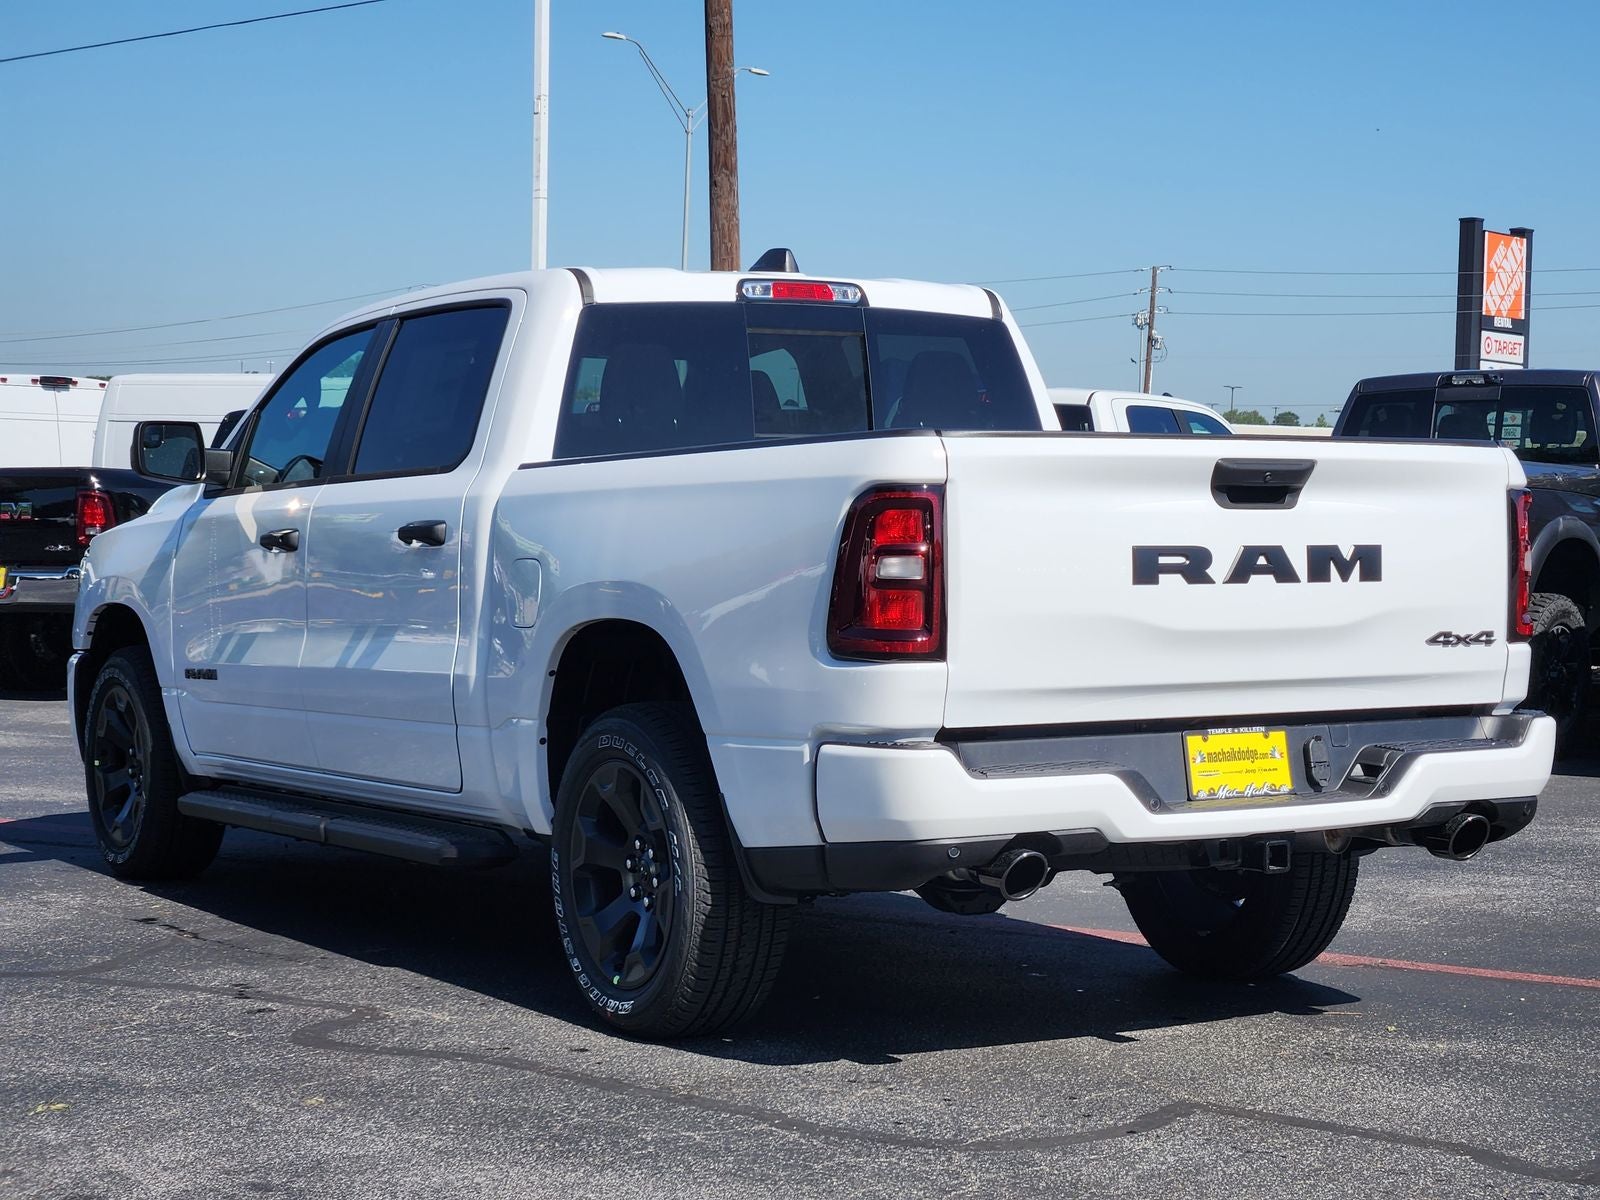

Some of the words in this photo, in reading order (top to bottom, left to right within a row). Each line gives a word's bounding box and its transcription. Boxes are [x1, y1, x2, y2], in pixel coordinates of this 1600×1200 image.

[1486, 237, 1523, 316] HOME
[1494, 339, 1522, 357] TARGET
[1132, 544, 1382, 586] RAM
[1424, 630, 1497, 648] 4x4
[1206, 746, 1270, 764] machaikdodge.com
[598, 734, 669, 811] DUELER
